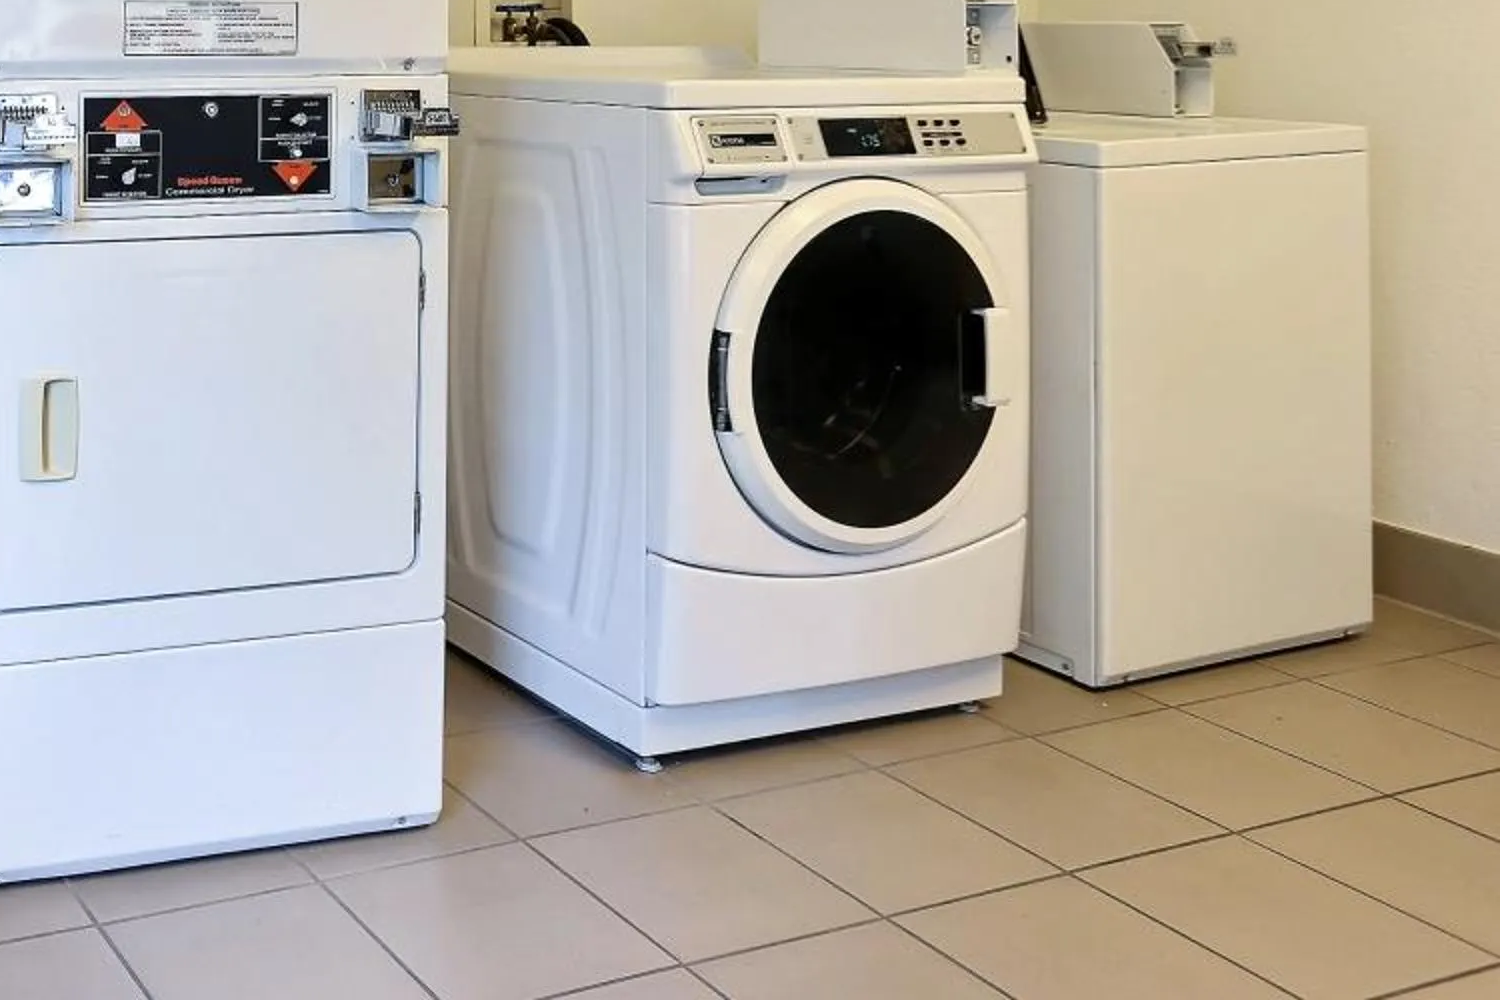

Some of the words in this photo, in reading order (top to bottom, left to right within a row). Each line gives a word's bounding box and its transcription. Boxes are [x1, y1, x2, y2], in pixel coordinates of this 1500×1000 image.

[177, 176, 209, 188] Speed
[165, 185, 225, 197] Commercial
[227, 184, 255, 196] Dryer
